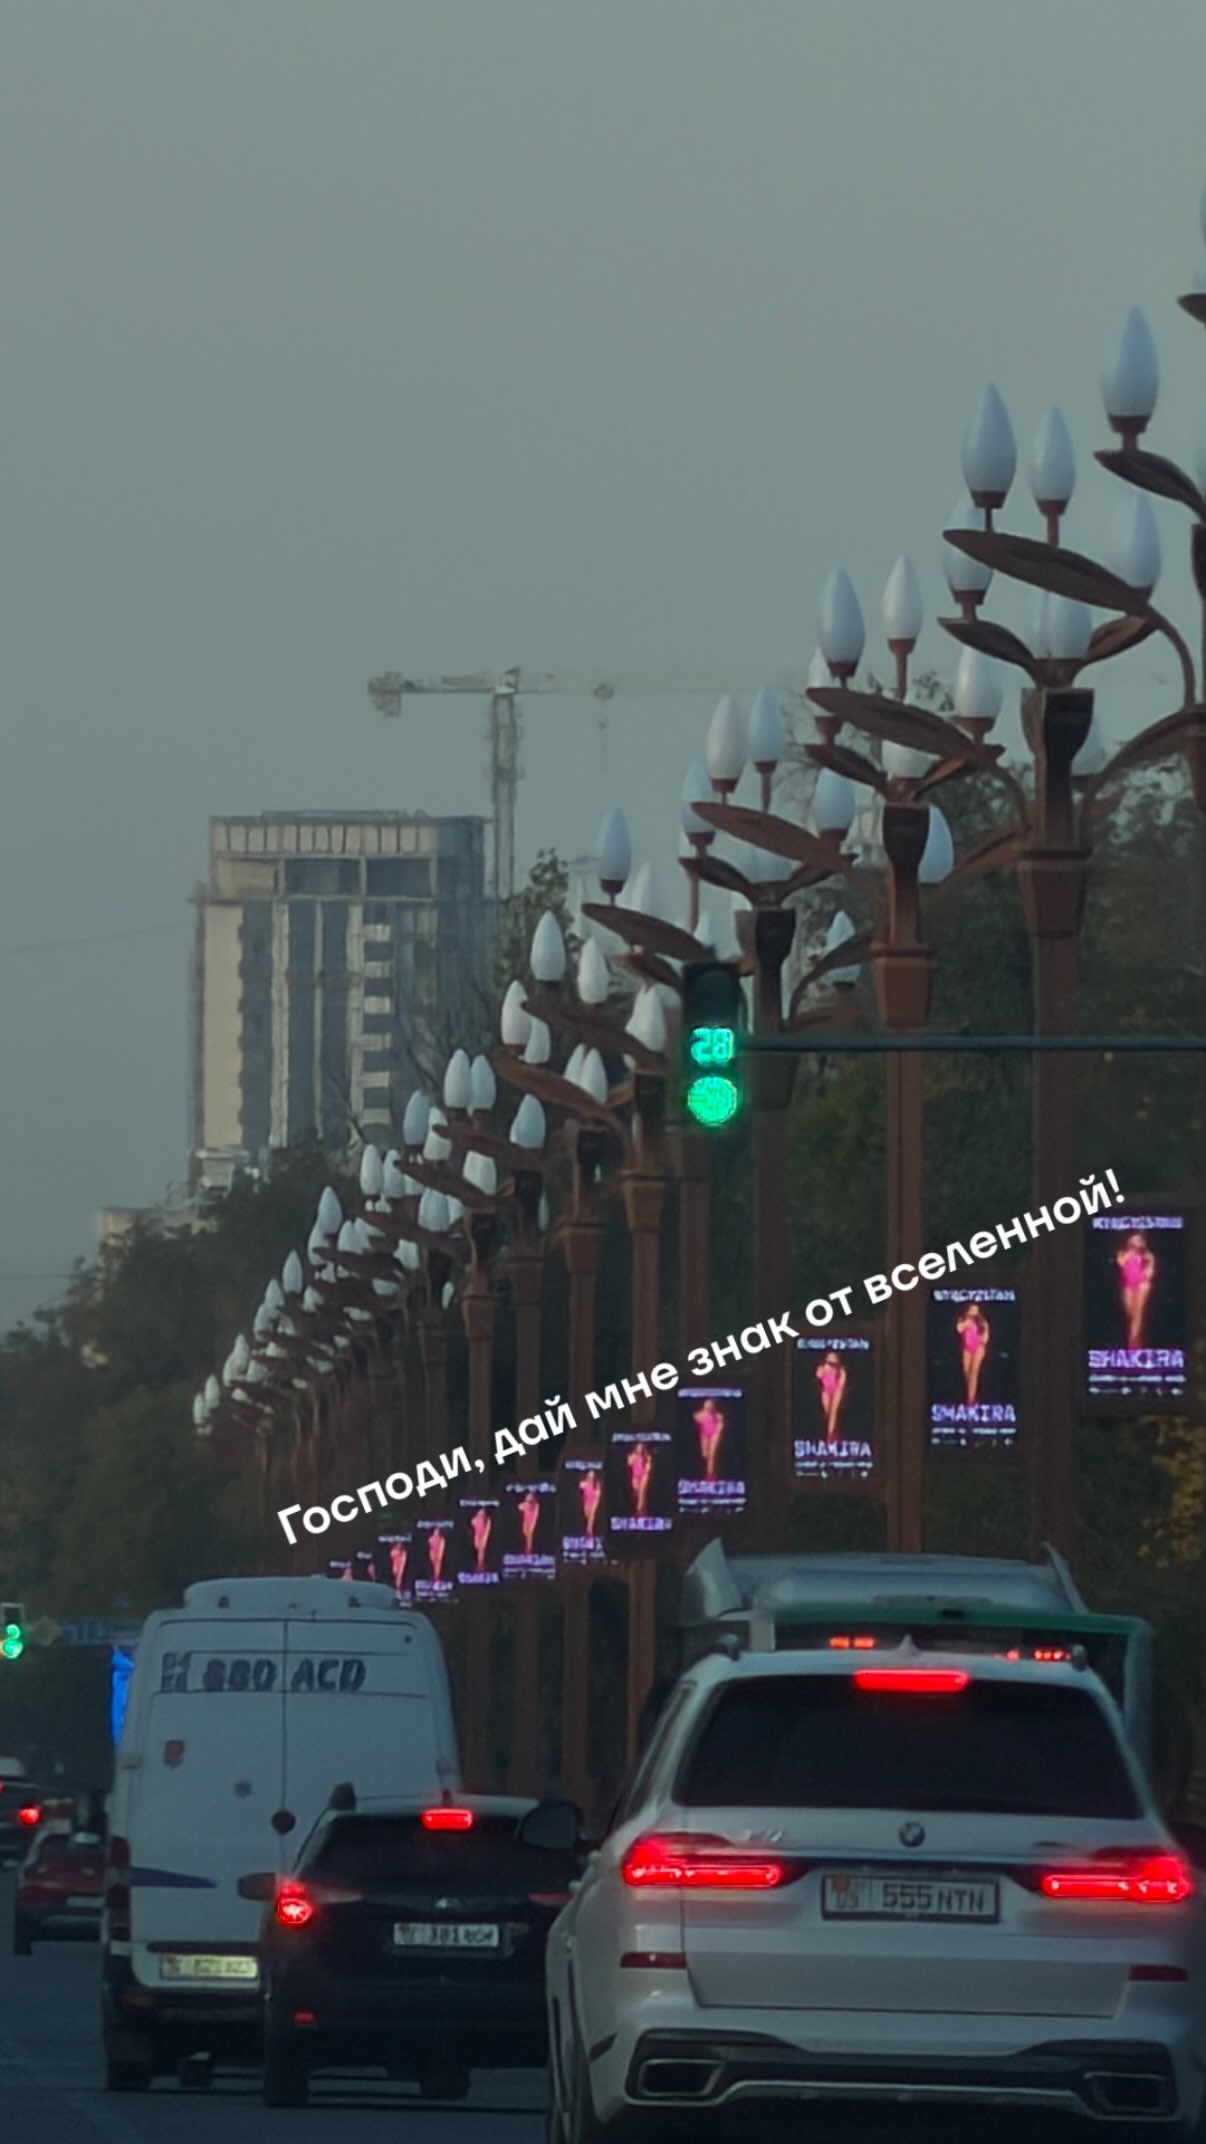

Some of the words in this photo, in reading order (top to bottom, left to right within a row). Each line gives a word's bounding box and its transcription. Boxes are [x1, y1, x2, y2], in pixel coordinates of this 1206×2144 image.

[1088, 1349, 1184, 1369] SHAKIRA
[931, 1403, 1016, 1423] SHAKIRA
[794, 1439, 872, 1458] SHAKIRA
